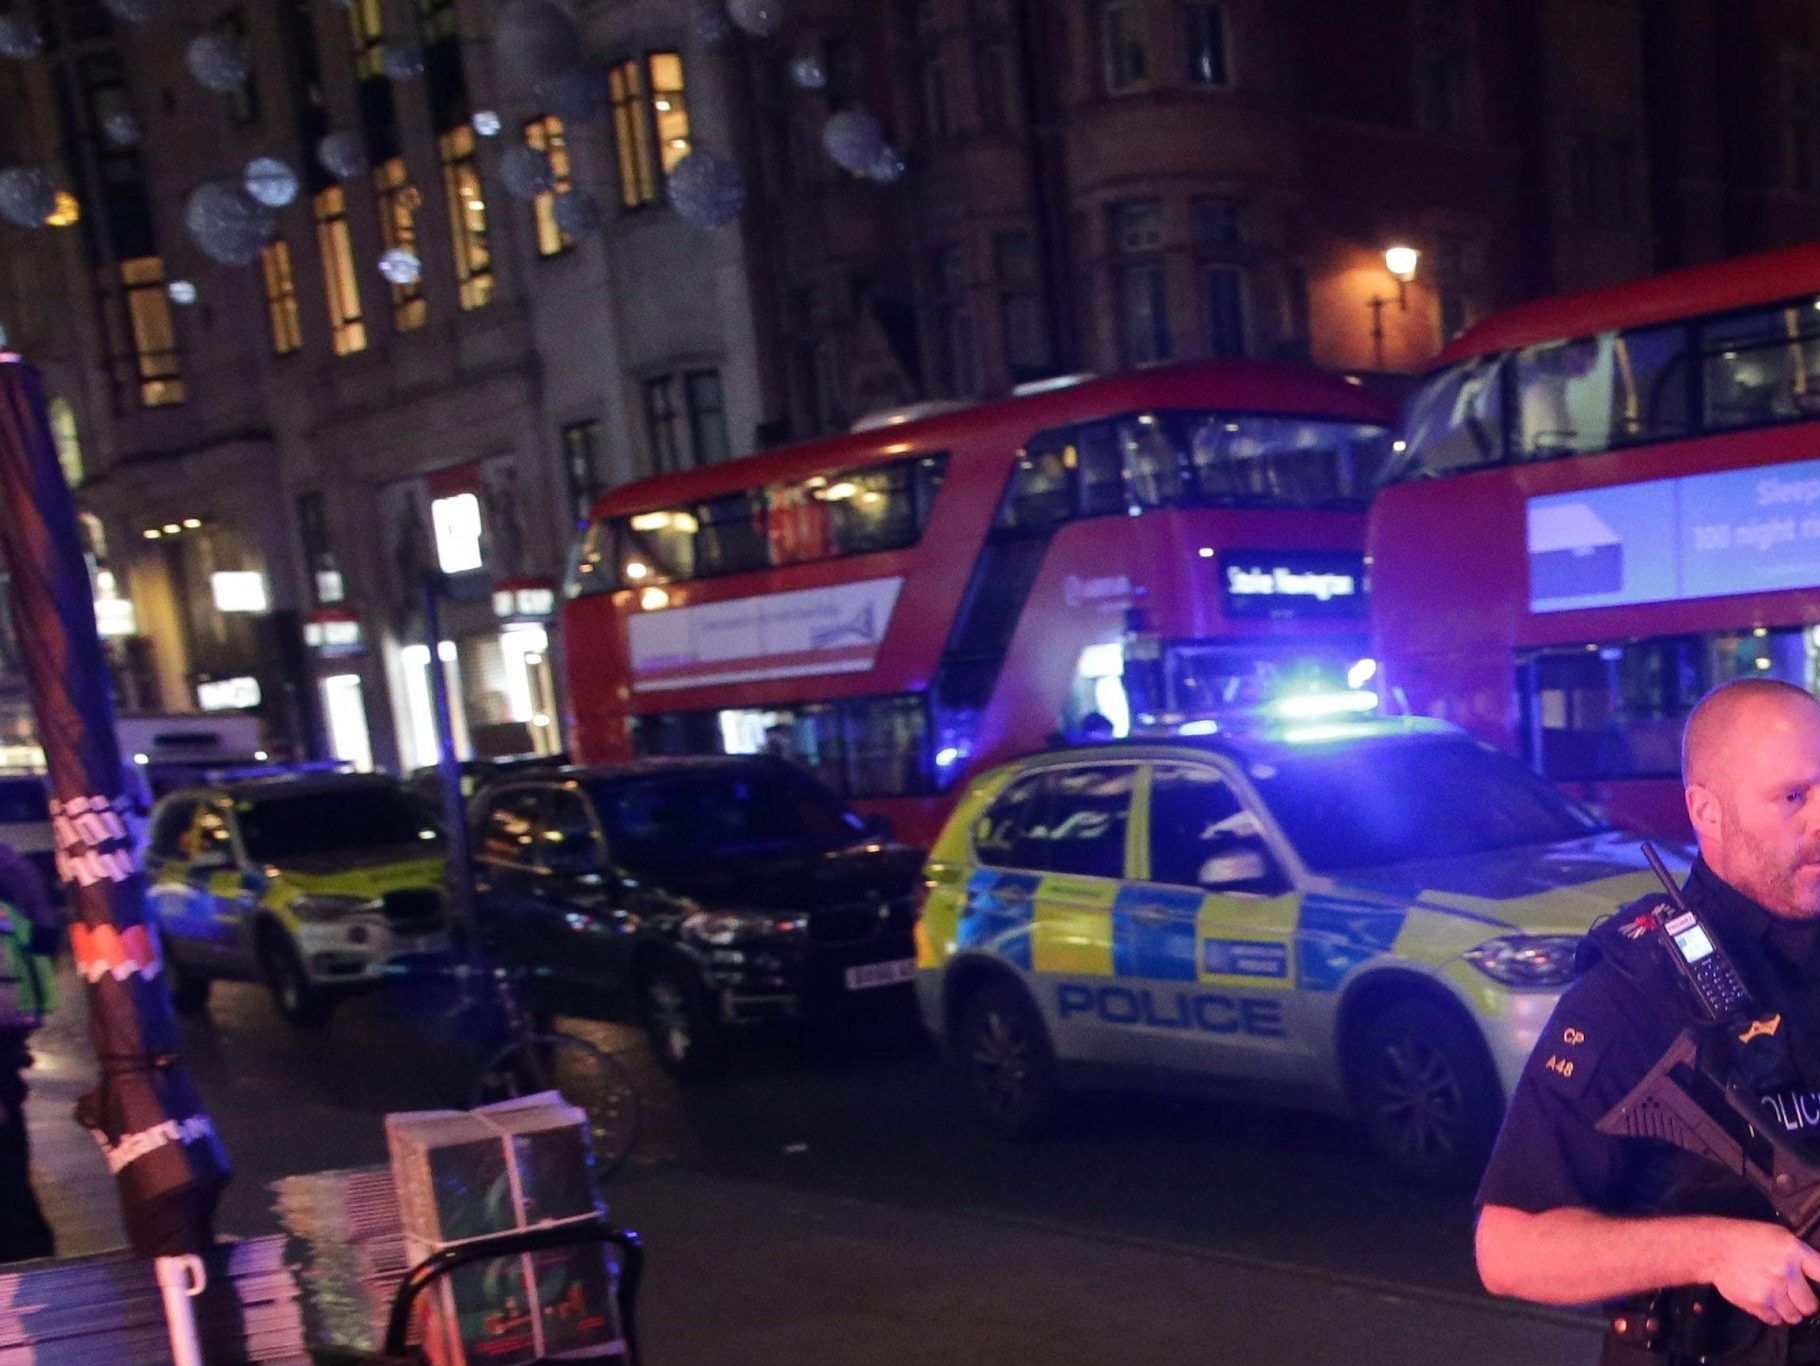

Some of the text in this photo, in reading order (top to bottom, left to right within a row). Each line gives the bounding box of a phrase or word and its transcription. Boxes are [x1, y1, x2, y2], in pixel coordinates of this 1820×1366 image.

[1058, 983, 1287, 1038] POLICE
[1563, 1027, 1585, 1046] CP
[1545, 1055, 1574, 1078] A48
